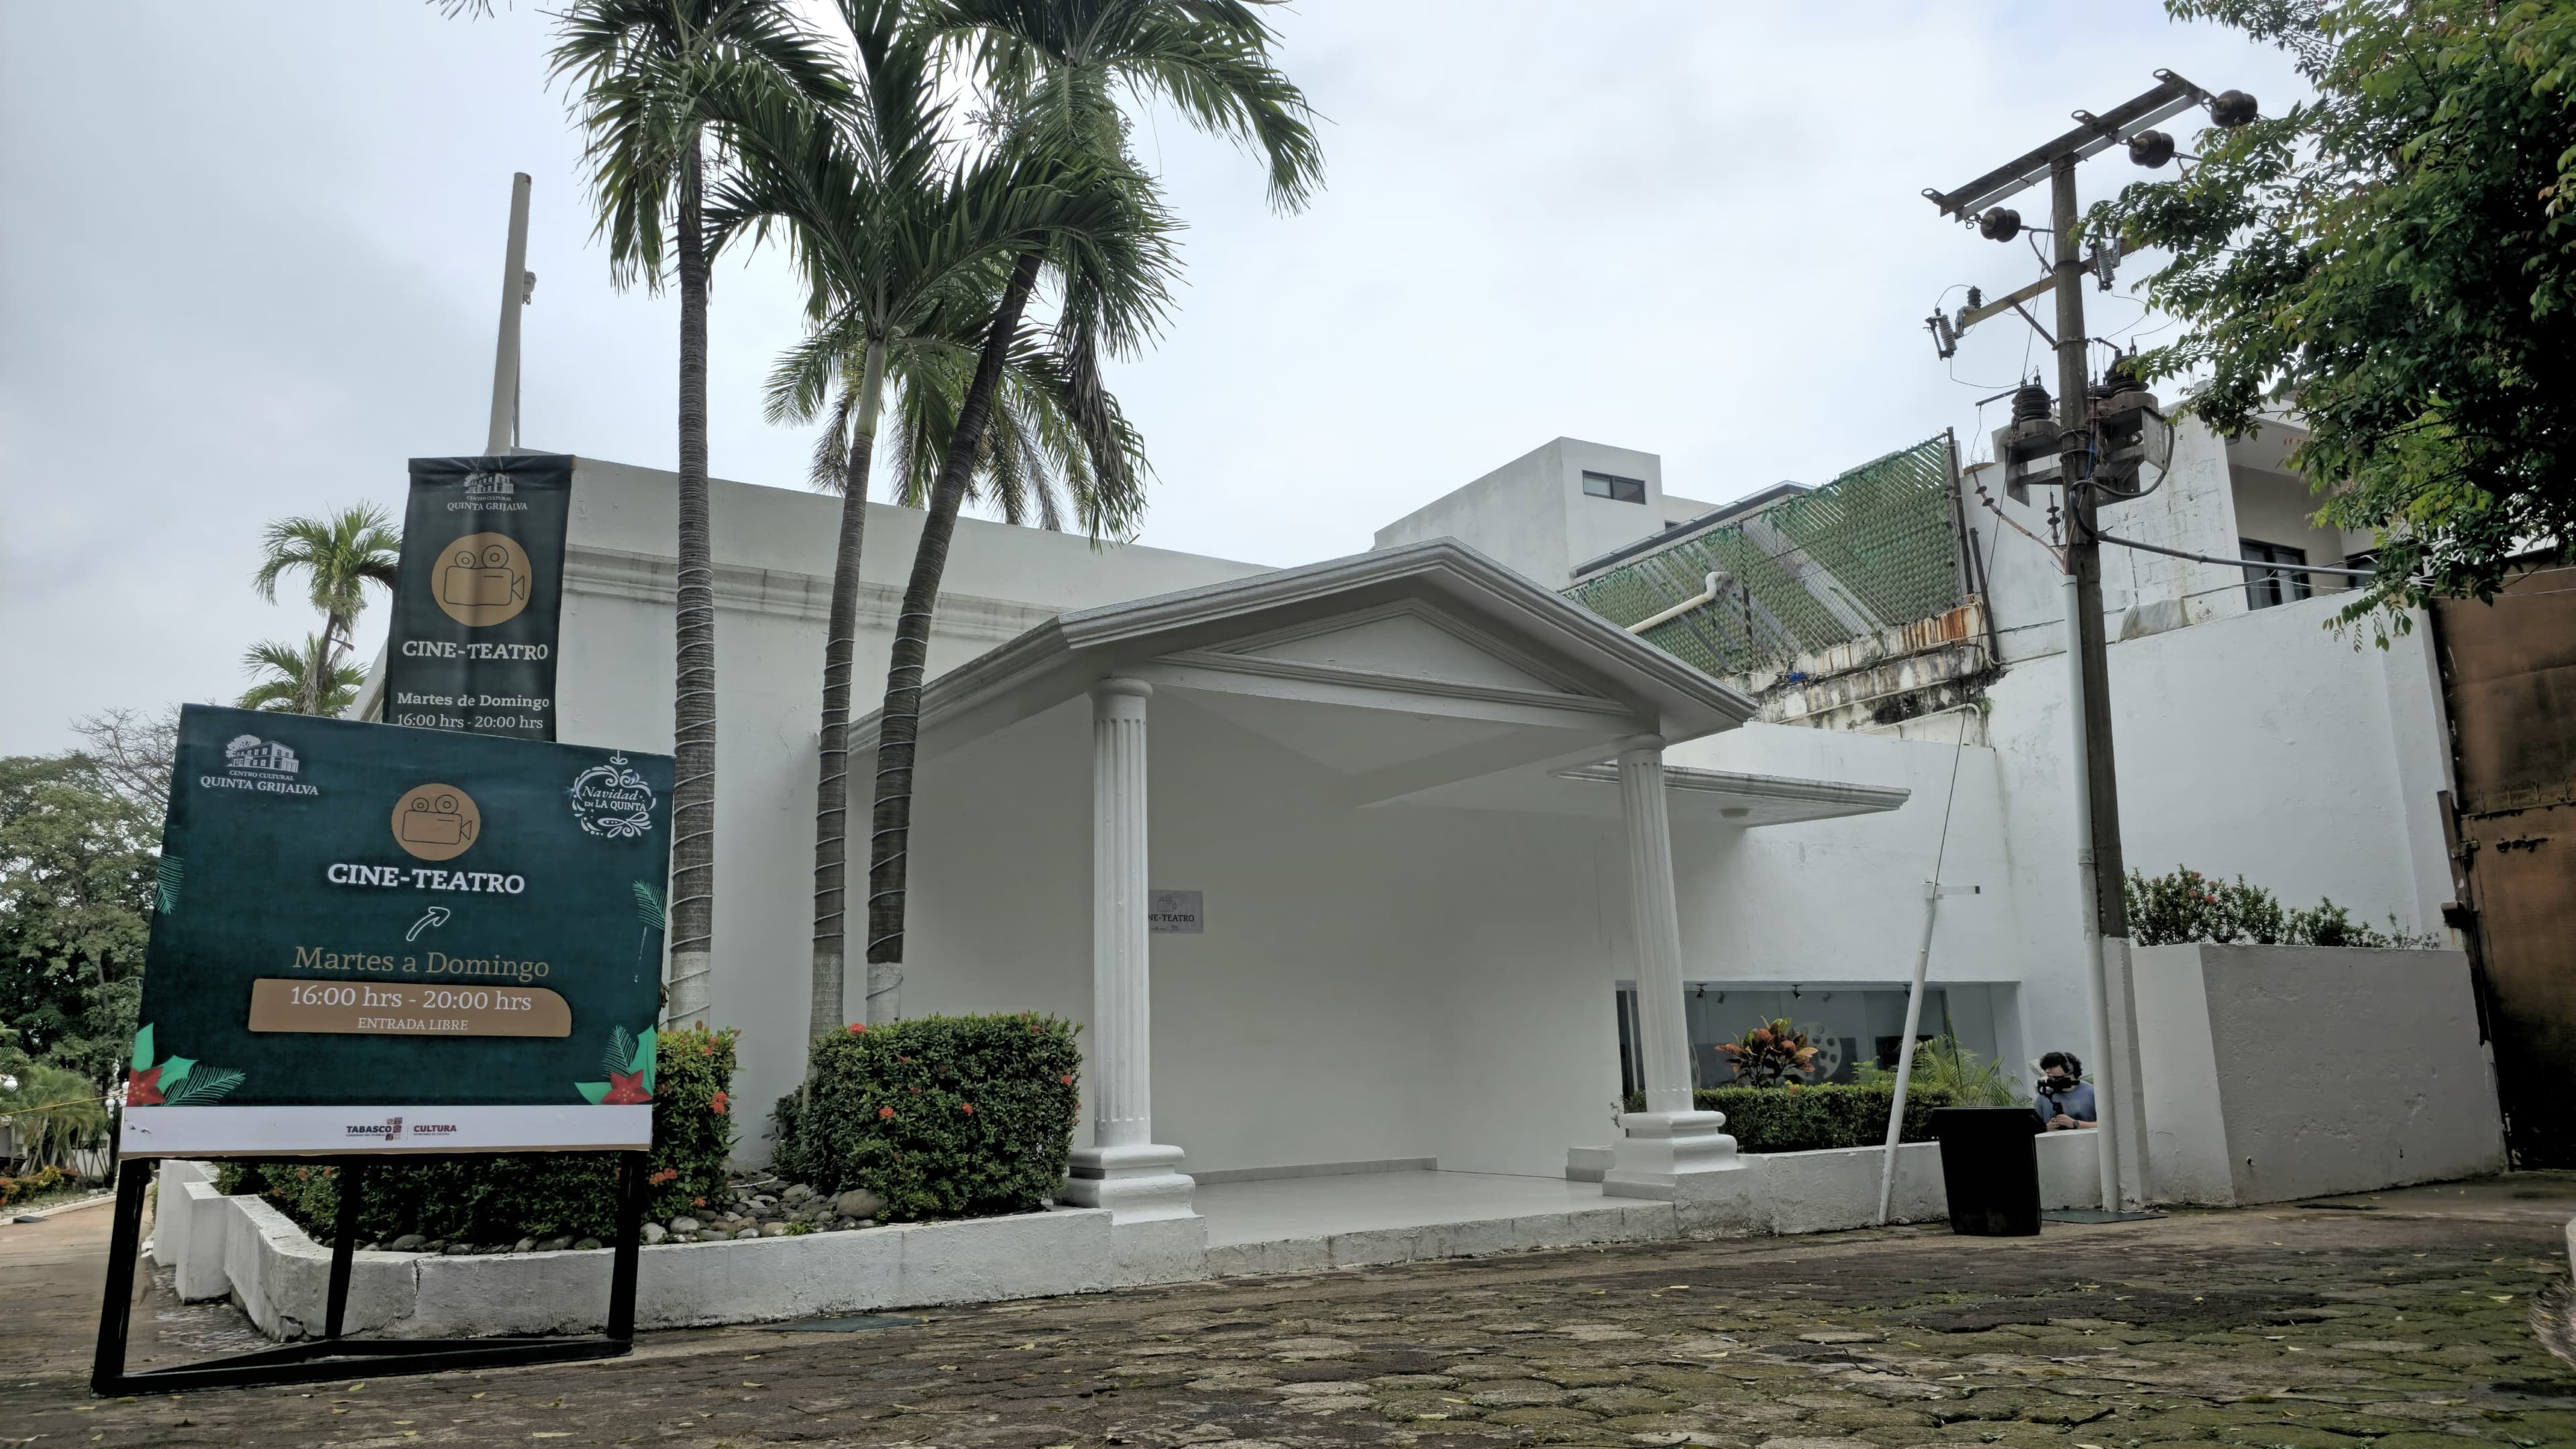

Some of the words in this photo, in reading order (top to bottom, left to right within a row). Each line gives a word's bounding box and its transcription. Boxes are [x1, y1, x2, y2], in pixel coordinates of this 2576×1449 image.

[447, 502, 484, 511] QUINTA
[486, 502, 528, 511] GRIJALVA
[402, 640, 548, 661] CINE-TEATRO
[397, 692, 453, 705] Martes
[458, 695, 476, 706] de
[480, 695, 549, 711] Domingo
[397, 713, 436, 727] 16:00
[439, 714, 464, 728] hrs
[475, 716, 516, 728] 20:00
[519, 715, 543, 729] hrs
[229, 769, 258, 777] CENTRO
[259, 772, 294, 781] CULTURAL
[201, 775, 254, 789] QUINTA
[257, 781, 319, 795] GRIJALVA
[582, 786, 639, 800] Navidad
[595, 799, 608, 808] LA
[610, 800, 647, 812] QUINTA
[327, 863, 525, 894] CINE-TEATRO
[1148, 914, 1195, 922] NE-TEATRO
[292, 947, 394, 972] Martes
[402, 957, 417, 973] a
[426, 952, 549, 981] Domingo
[290, 985, 356, 1006] 16:00
[362, 986, 402, 1007] hrs
[422, 990, 488, 1010] 20:00
[494, 990, 532, 1011] hrs
[358, 1018, 425, 1030] ENTRADA
[429, 1019, 468, 1031] LIBRE
[413, 1124, 457, 1132] CULTURA
